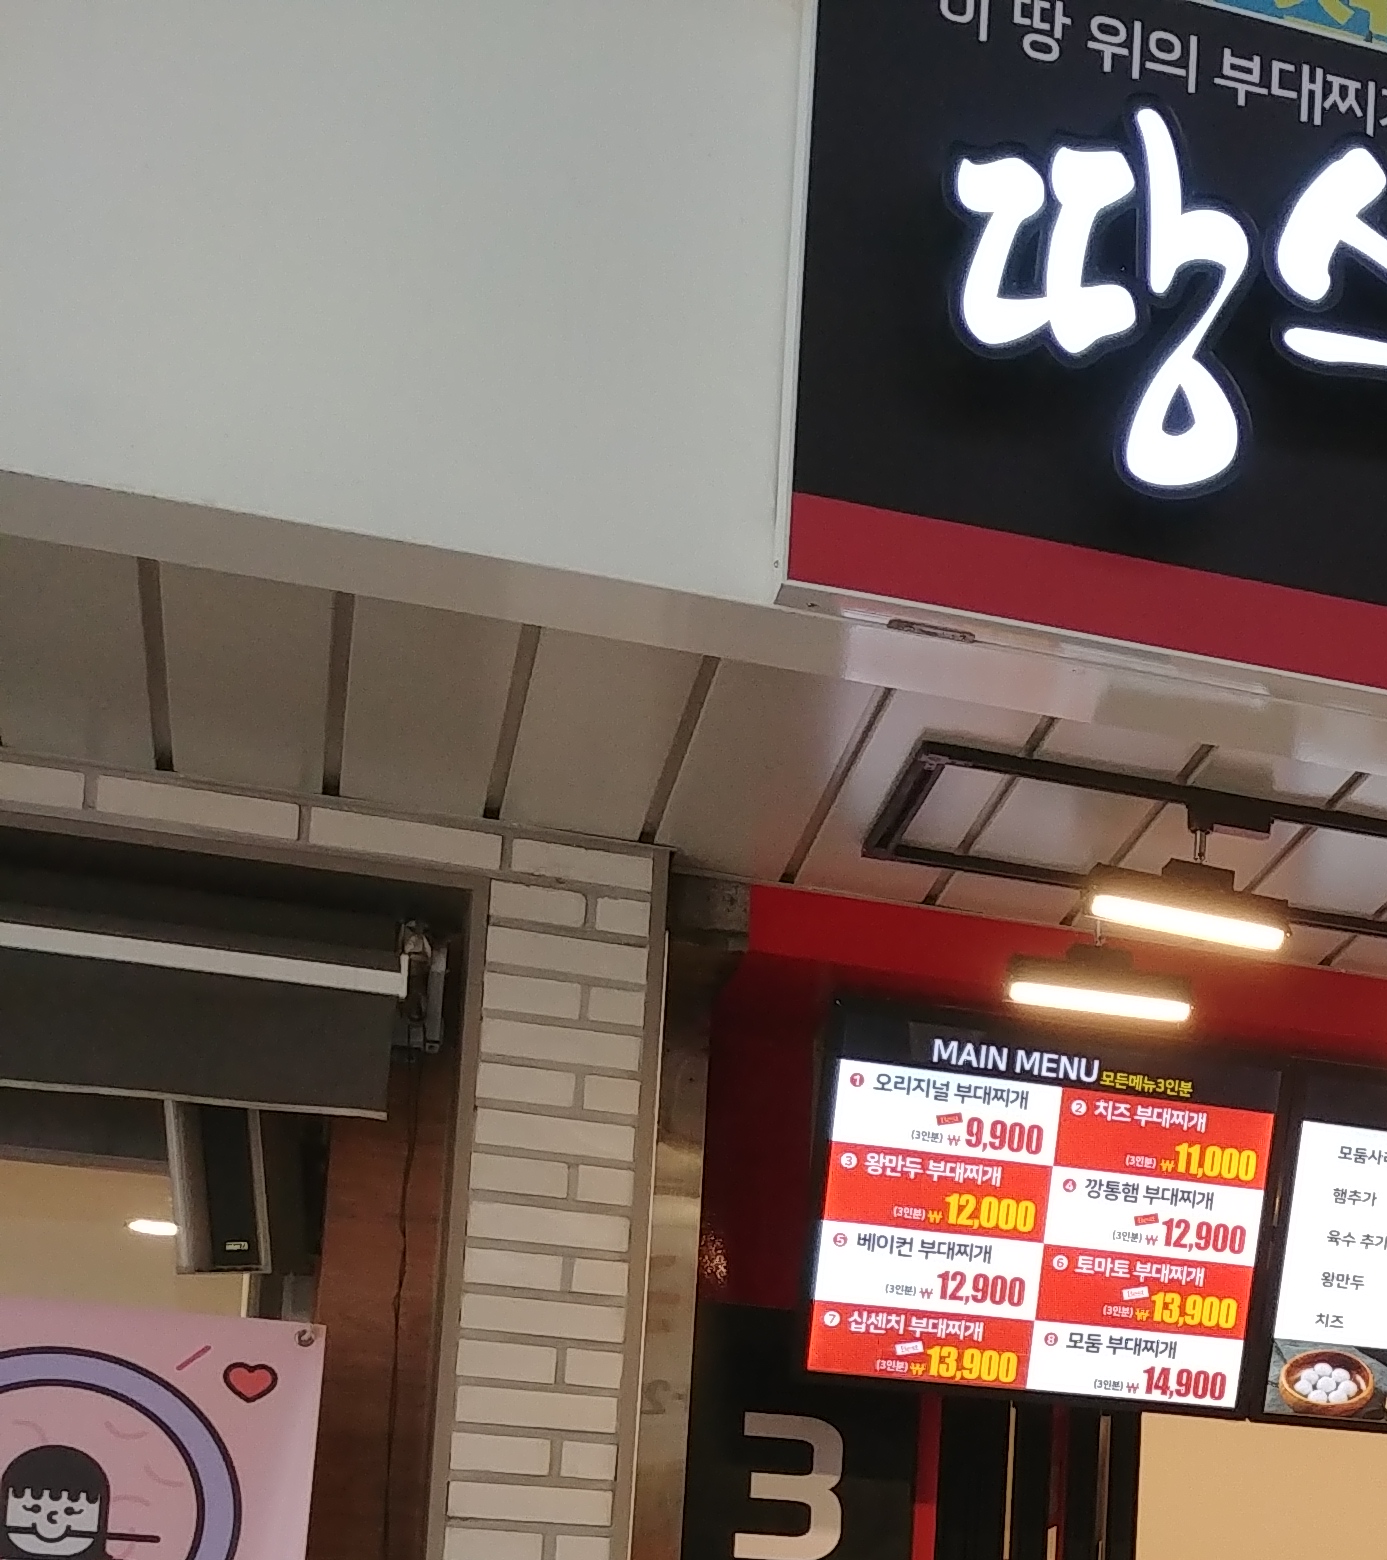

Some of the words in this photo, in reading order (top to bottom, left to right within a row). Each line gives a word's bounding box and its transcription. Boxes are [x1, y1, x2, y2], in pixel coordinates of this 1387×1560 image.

[1086, 14, 1197, 94] 위의
[931, 1037, 1008, 1074] MAIN
[1013, 1053, 1100, 1083] MENU
[872, 1072, 951, 1104] 오리지널
[953, 1080, 1030, 1111] 부대찌개
[1094, 1098, 1132, 1126] 치즈
[1134, 1102, 1207, 1134] 부대찌개
[964, 1115, 1044, 1157] 9,900
[863, 1151, 924, 1181] 왕만두
[926, 1158, 1002, 1189] 부대찌개
[1174, 1142, 1258, 1183] 11,000
[1084, 1178, 1139, 1206] 깡통햄
[1142, 1185, 1215, 1211] 부대찌개
[1325, 1228, 1356, 1250] 육수
[847, 1308, 905, 1337] 십센치
[908, 1317, 985, 1343] 부대찌개
[1065, 1331, 1105, 1356] 모둠
[1107, 1335, 1178, 1360] 부대찌개
